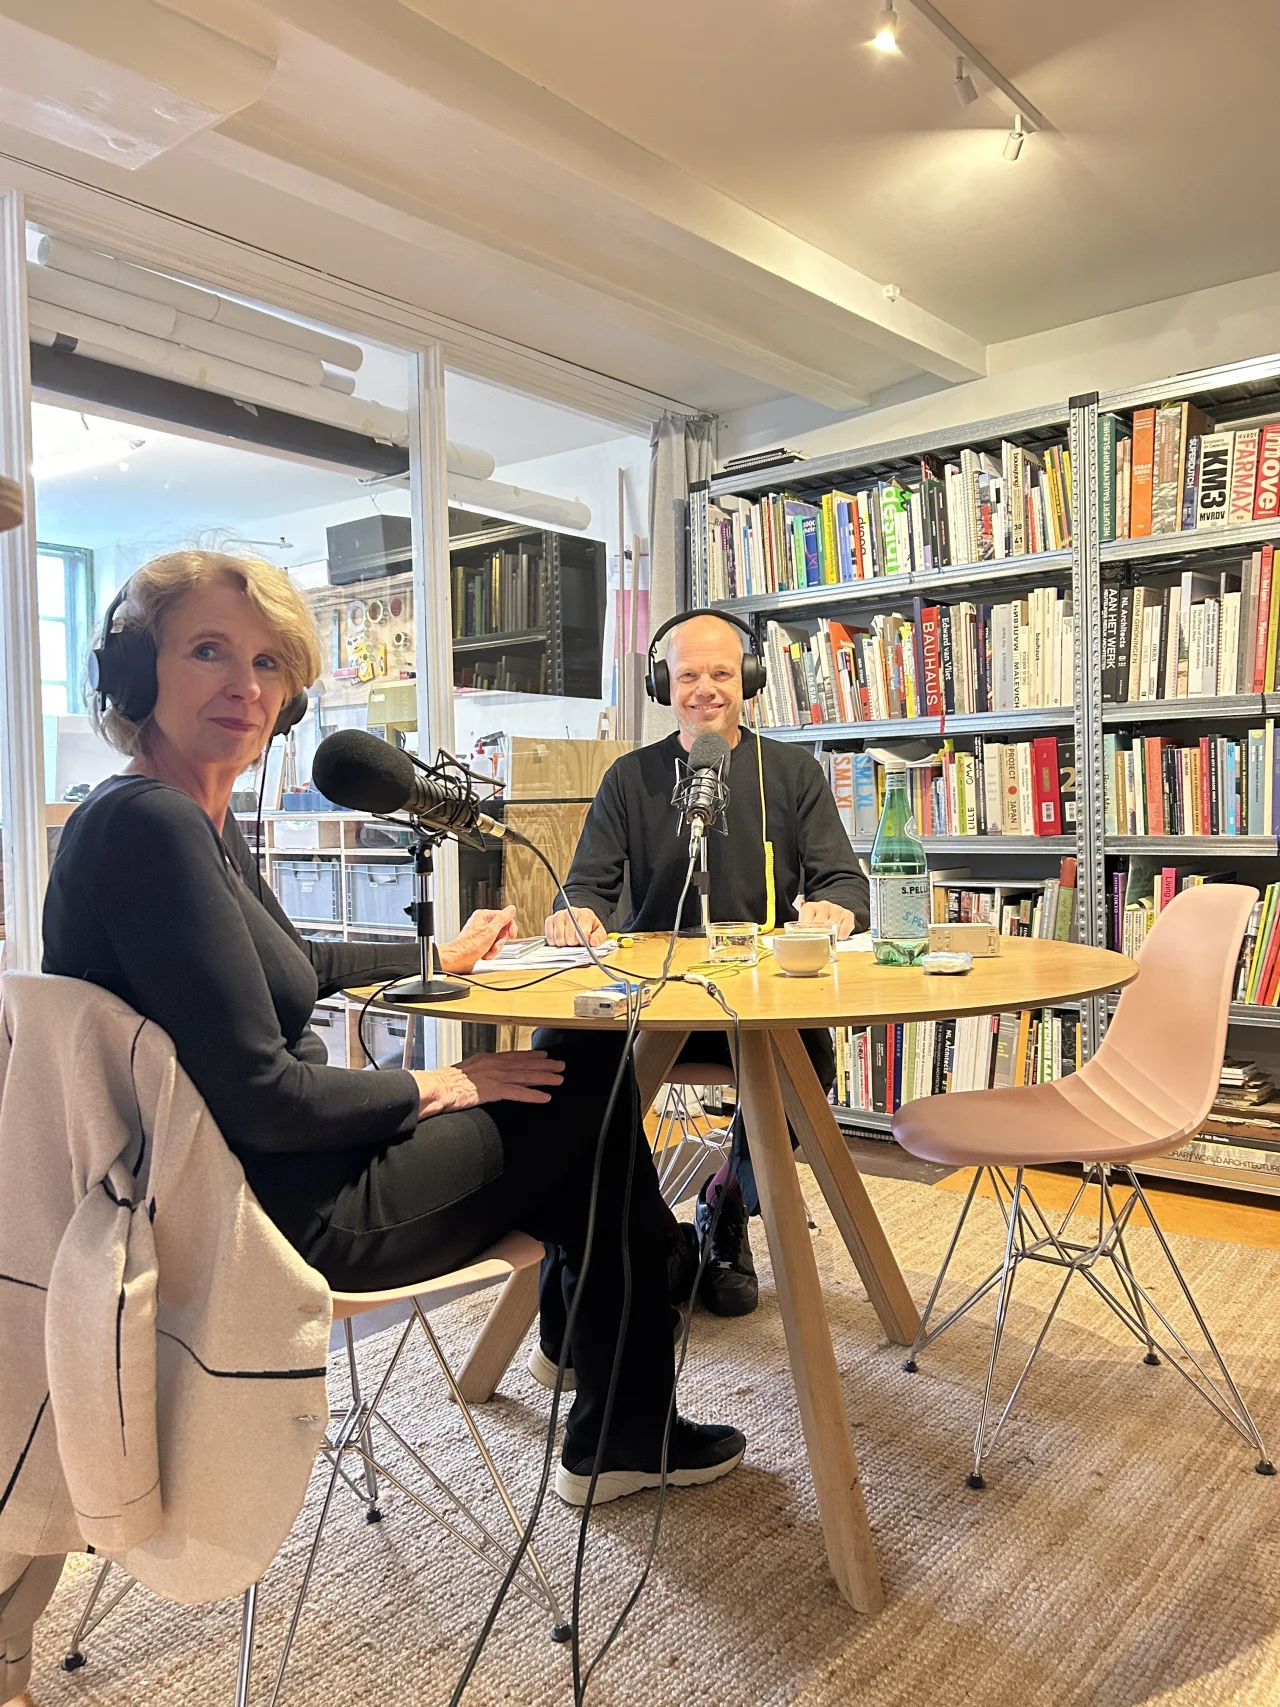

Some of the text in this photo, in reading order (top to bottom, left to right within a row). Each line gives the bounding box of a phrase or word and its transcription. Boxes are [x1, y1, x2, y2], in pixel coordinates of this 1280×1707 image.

[1103, 421, 1111, 537] NEUFERT BAUENTWURFSLEHRE
[1186, 438, 1198, 489] SUPERDUTCH
[1200, 449, 1229, 510] KM3
[1231, 440, 1257, 515] FARMAX
[1200, 511, 1226, 521] MVRDV
[941, 617, 953, 681] Edward van Vliet
[1106, 588, 1118, 670] AAN HET WERK
[1119, 597, 1129, 648] NL Architects
[1132, 589, 1142, 664] FORUM GRONINGEN
[922, 622, 938, 705] BAUHAUS
[965, 763, 974, 785] OMA
[1008, 749, 1018, 824] PROJECT JAPAN
[967, 807, 976, 830] LILLE
[1163, 876, 1173, 898] Living
[945, 1030, 952, 1039] NL
[1194, 1154, 1222, 1164] WORLD
[1222, 1157, 1280, 1173] ARCHITECTURE
